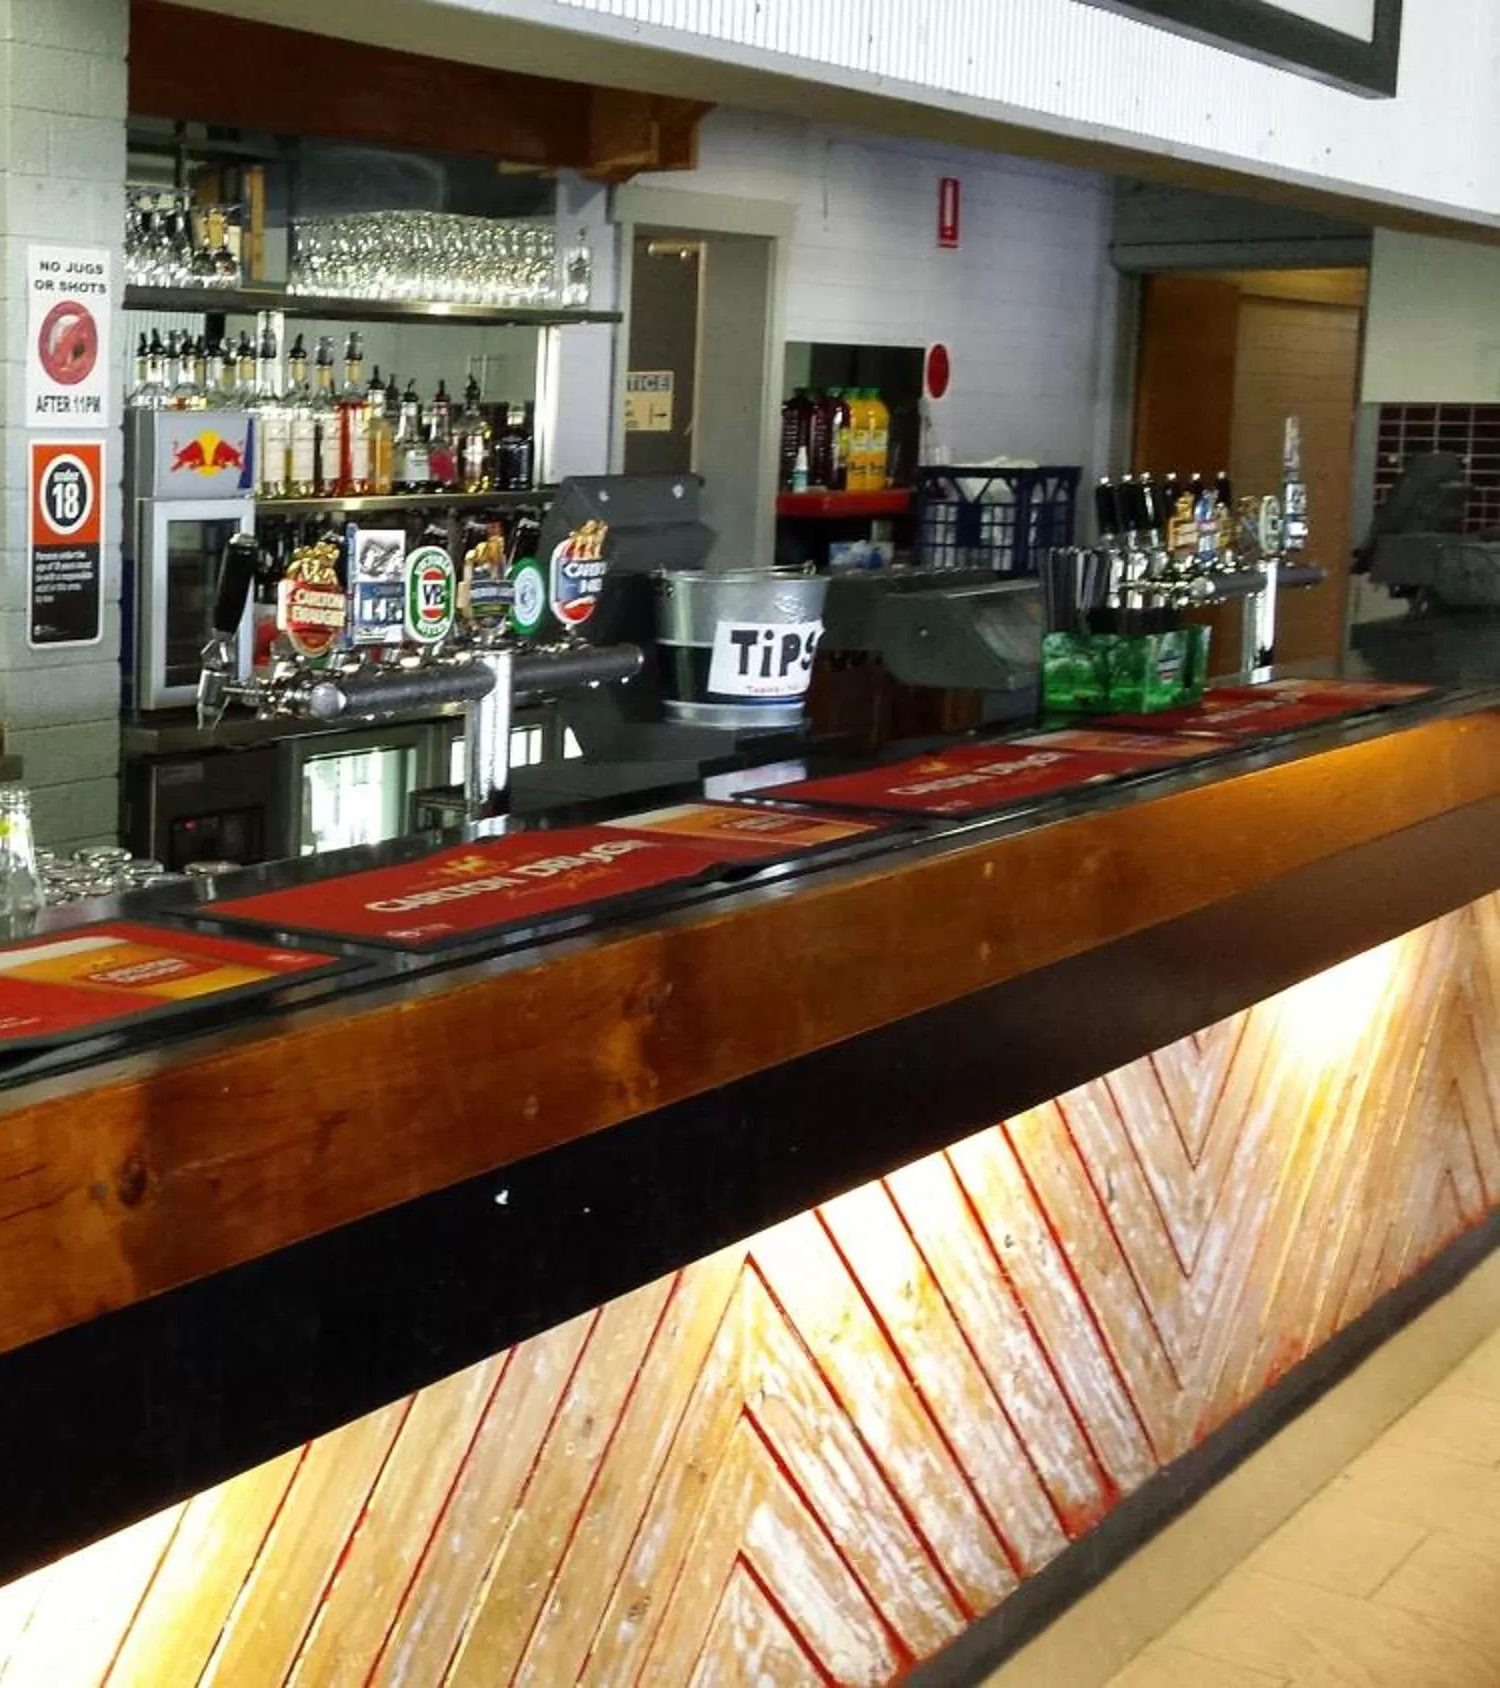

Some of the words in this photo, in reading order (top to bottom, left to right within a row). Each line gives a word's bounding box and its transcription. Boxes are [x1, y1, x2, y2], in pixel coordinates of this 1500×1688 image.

[39, 260, 61, 273] NO
[65, 261, 104, 275] JUGS
[34, 278, 55, 291] OR
[59, 280, 107, 294] SHOTS
[627, 375, 670, 391] TICE
[36, 395, 71, 413] AFTER
[51, 483, 80, 519] 18
[423, 583, 445, 605] VB
